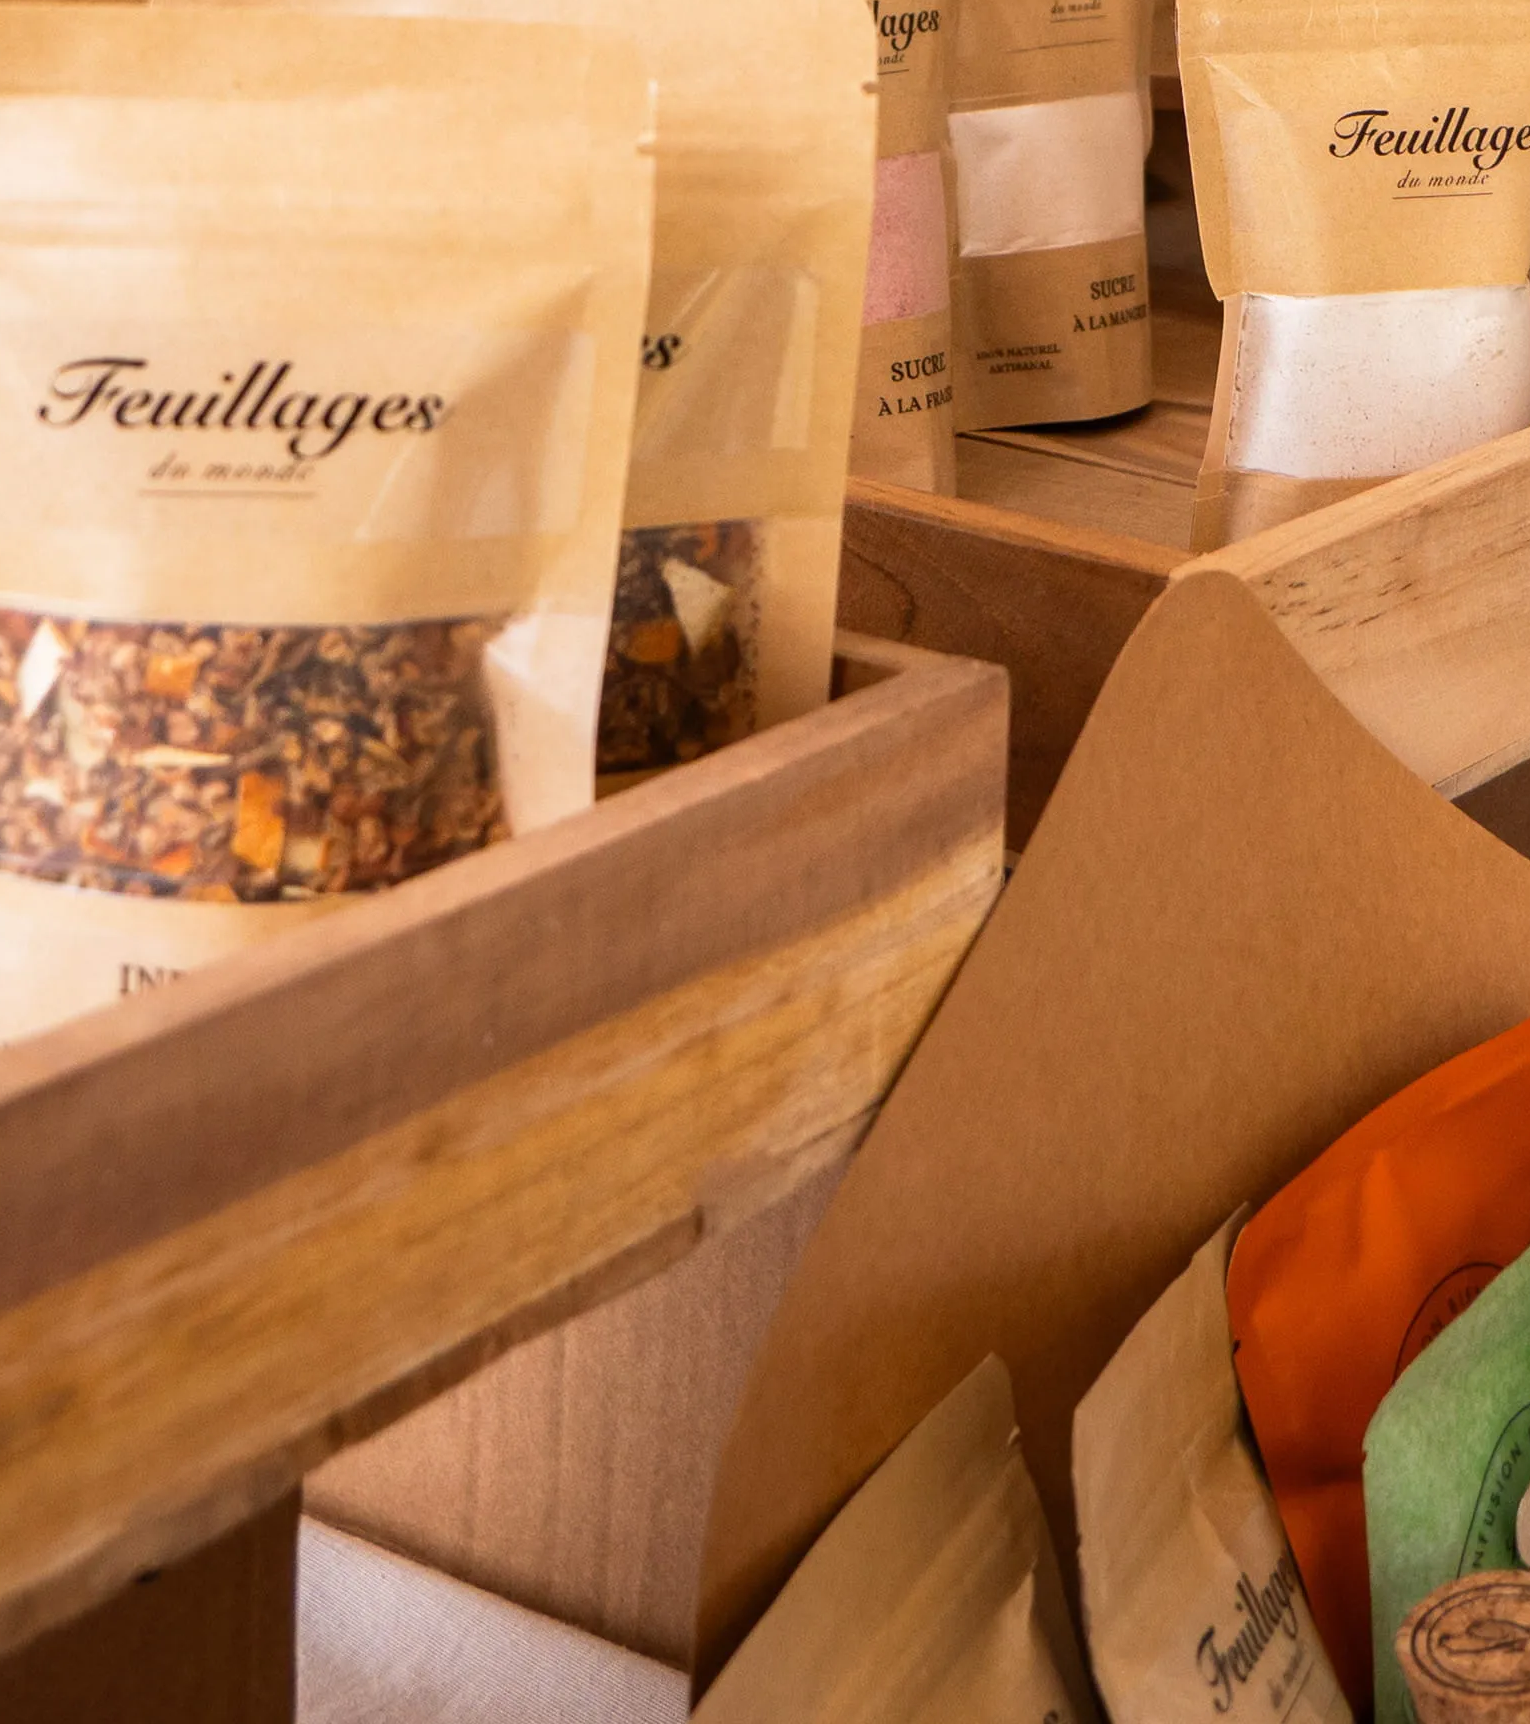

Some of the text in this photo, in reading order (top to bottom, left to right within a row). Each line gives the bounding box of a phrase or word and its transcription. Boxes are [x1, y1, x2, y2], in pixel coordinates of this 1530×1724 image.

[873, 0, 940, 51] lages
[1396, 167, 1490, 190] du monde
[1089, 274, 1136, 301] SUCRE
[1072, 314, 1087, 333] À
[1088, 312, 1109, 331] LA
[890, 351, 947, 382] SUCRE
[36, 356, 451, 462] Feuillages
[877, 396, 893, 417] À
[897, 394, 922, 414] LA
[1472, 1446, 1523, 1568] NFUSION
